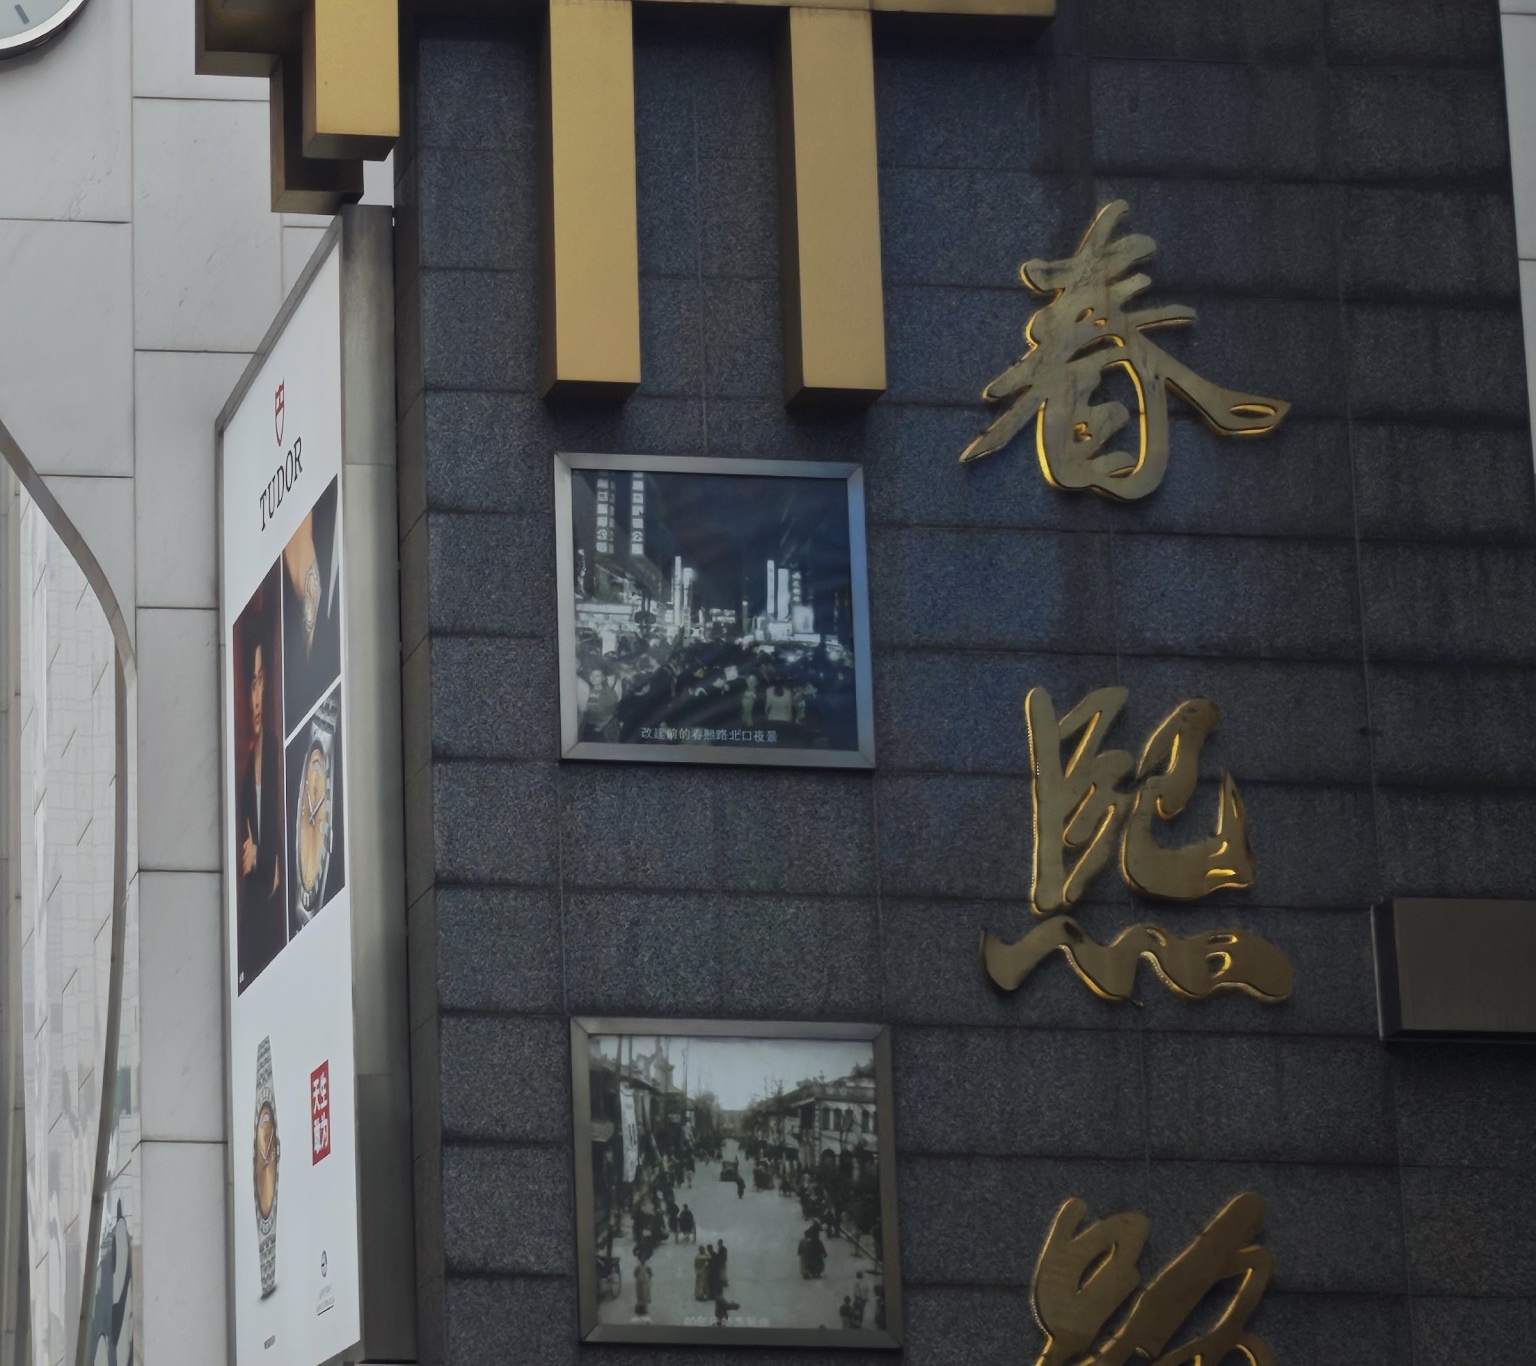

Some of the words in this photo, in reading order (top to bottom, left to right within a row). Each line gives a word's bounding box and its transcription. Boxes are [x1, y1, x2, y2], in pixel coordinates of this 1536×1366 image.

[259, 436, 303, 531] TUDOR
[640, 726, 778, 744] 改建前的春熙路北口夜景
[311, 1072, 328, 1113] 天生
